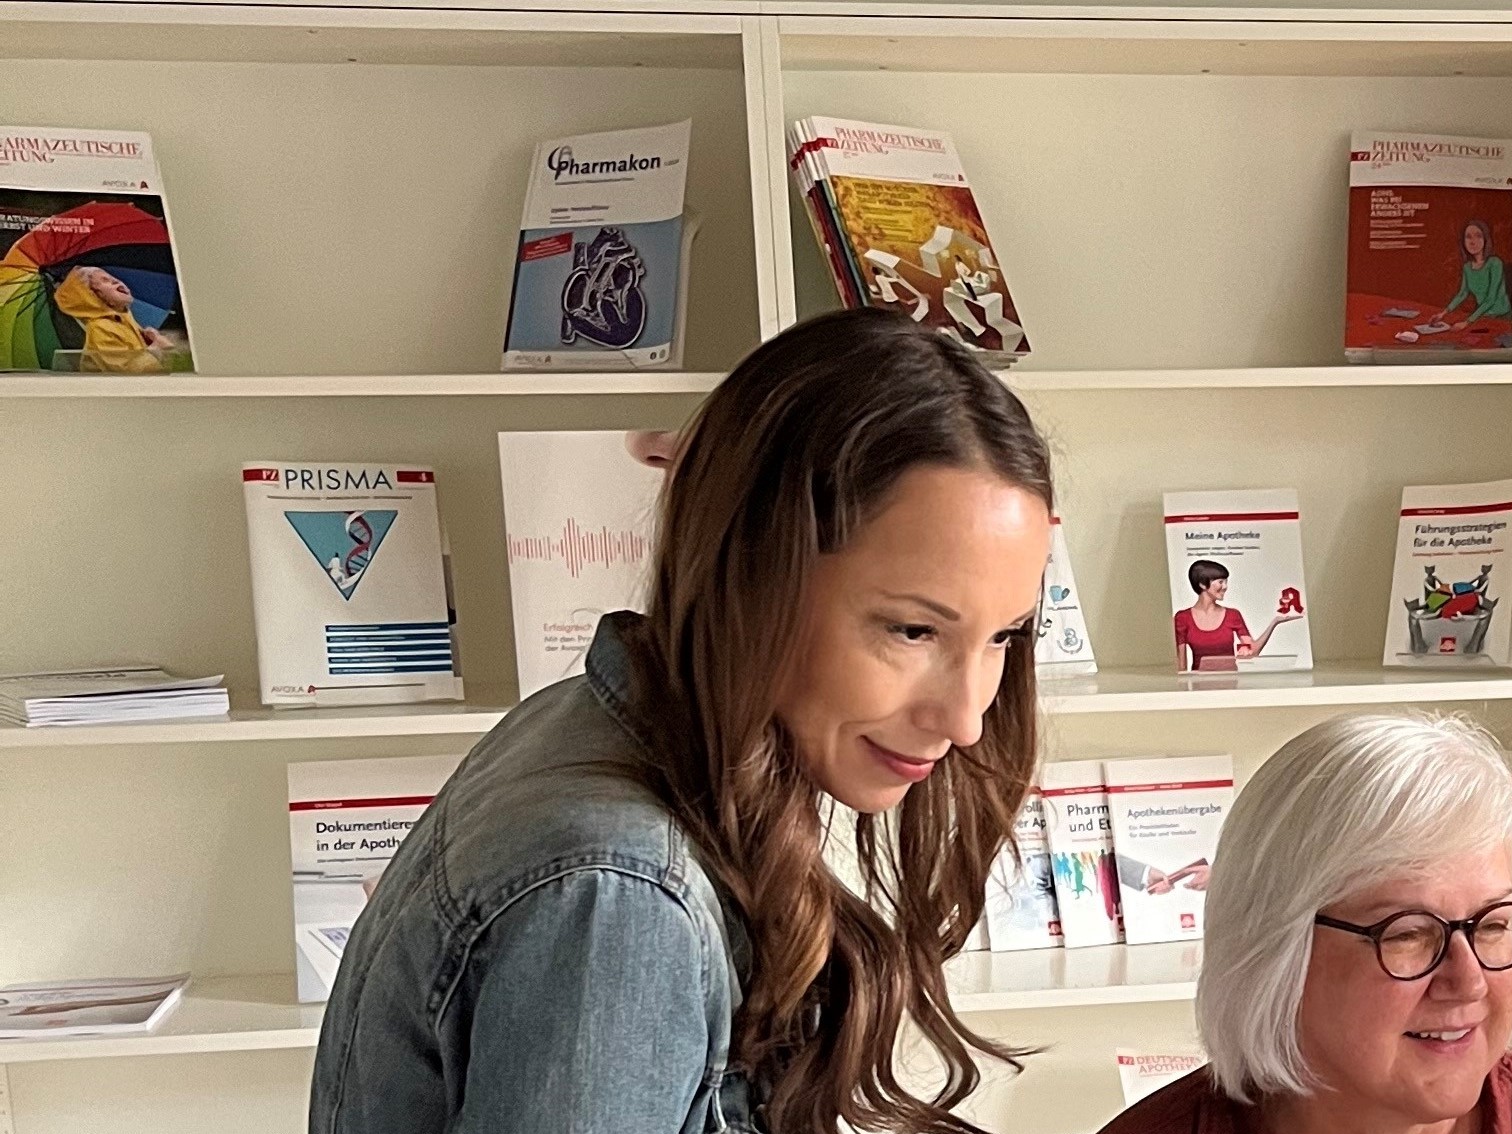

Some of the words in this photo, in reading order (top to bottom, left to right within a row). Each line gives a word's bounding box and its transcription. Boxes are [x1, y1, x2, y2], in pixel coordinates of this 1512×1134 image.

[548, 146, 661, 180] Pharmakon
[285, 469, 392, 490] PRISMA
[1069, 818, 1094, 832] und
[316, 840, 328, 851] in
[333, 838, 355, 851] der
